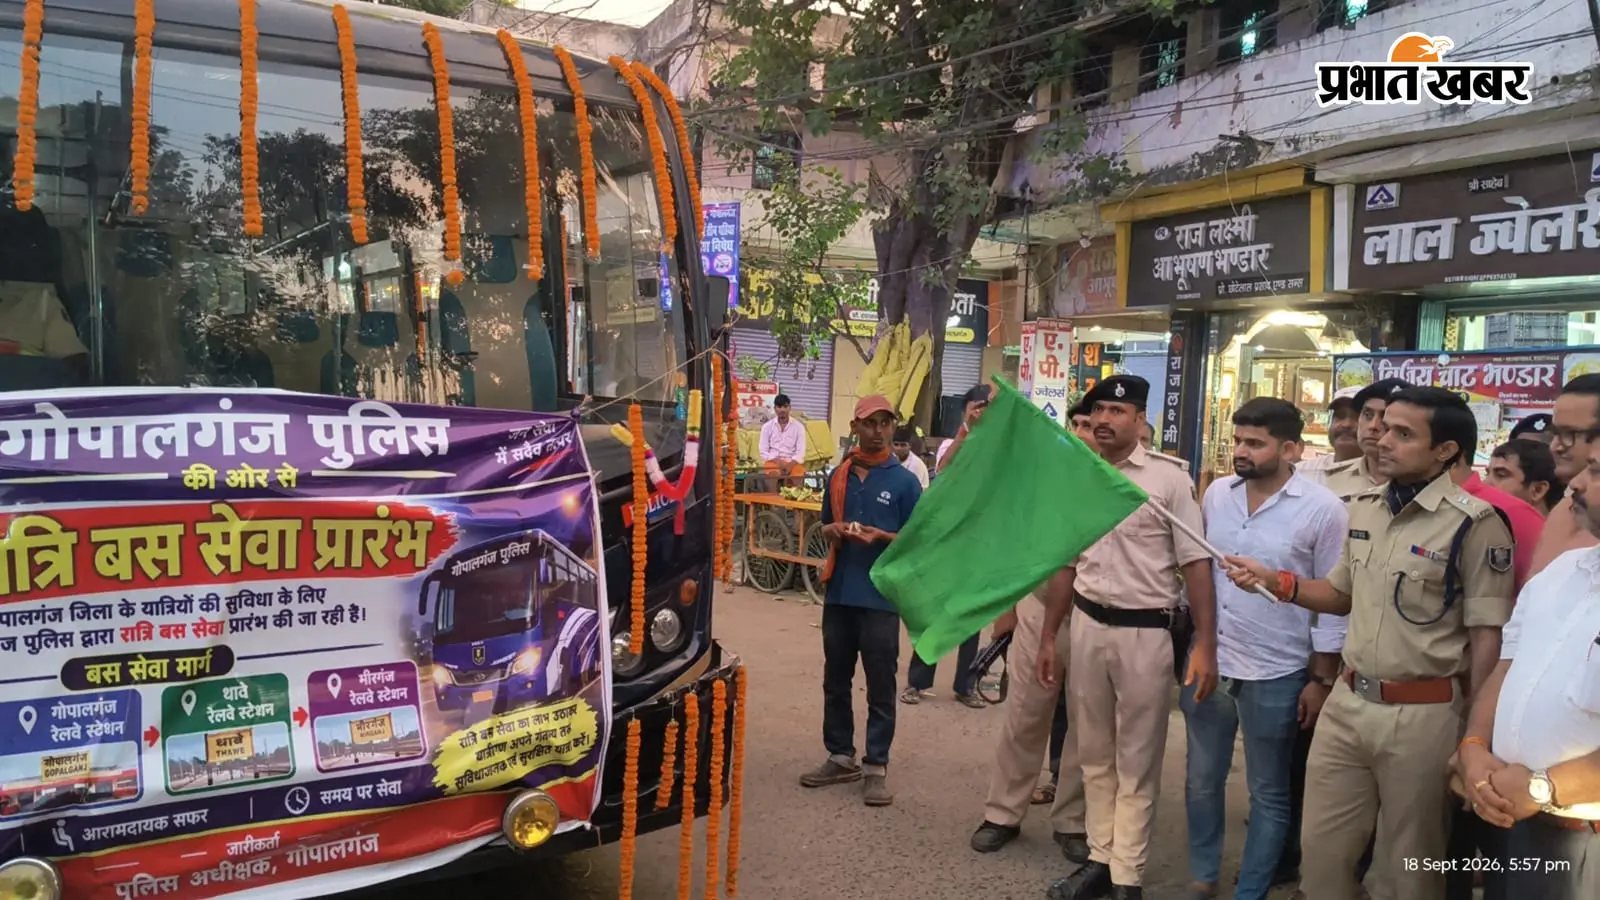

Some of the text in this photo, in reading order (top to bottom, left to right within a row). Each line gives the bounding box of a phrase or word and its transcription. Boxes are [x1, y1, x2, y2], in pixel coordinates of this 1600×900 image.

[1174, 204, 1259, 250] राज लक्ष्मी
[1363, 216, 1462, 266] लाल
[1214, 243, 1274, 275] भण्डार
[1483, 363, 1557, 387] भण्डार
[0, 397, 450, 469] गोपालगंज पुलिस
[495, 446, 507, 464] में
[511, 441, 543, 461] सदैव
[182, 462, 299, 489] की ओर से
[0, 503, 432, 595] ात्रि बस सेवा प्रारंभ
[451, 542, 531, 576] गोपालगंज पुलिस
[0, 585, 327, 627] पालगंज जिला के यात्रियों की सुविधा के लिए
[23, 628, 74, 655] पुलिस
[80, 628, 115, 648] द्वारा
[120, 622, 153, 645] रात्रि
[159, 622, 186, 640] बस
[192, 616, 225, 638] सेवा
[229, 613, 268, 634] प्रारंभ
[272, 608, 293, 628] की
[298, 610, 317, 627] जा
[321, 604, 345, 625] रही
[85, 648, 213, 685] बस सेवा मार्ग
[358, 669, 396, 686] मीरगंज
[222, 680, 250, 702] थावे
[349, 686, 408, 706] रेलवे स्टेशन
[51, 697, 118, 720] गोपालगंज
[206, 701, 275, 723] रेलवे स्टेशन
[51, 719, 125, 744] रेलवे स्टेशन
[496, 720, 516, 735] सेवा
[516, 717, 530, 729] का
[510, 733, 532, 750] अपने
[320, 779, 402, 805] समय पर सेवा
[82, 808, 208, 842] आरामदायक सफर
[226, 831, 281, 857] जारीकर्ता
[115, 831, 380, 900] पुलिस अधीक्षक, गोपालगंज
